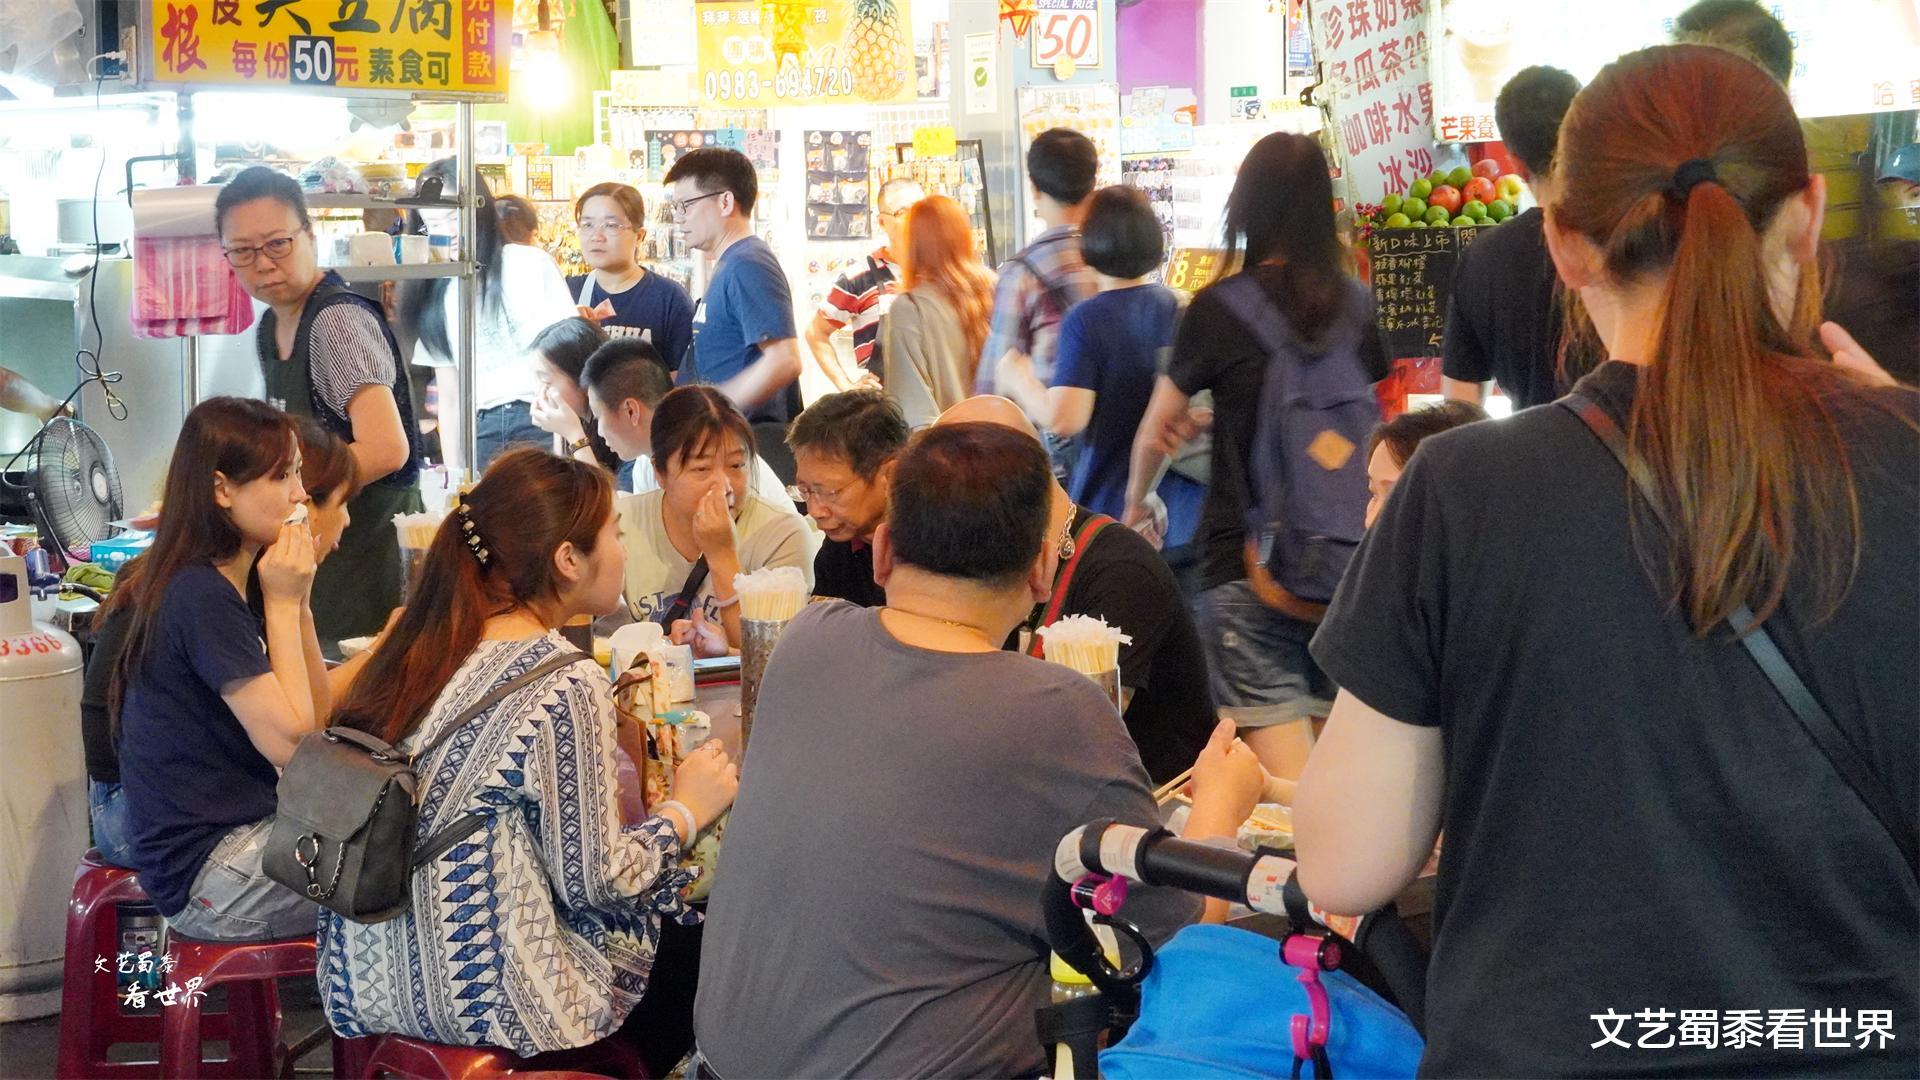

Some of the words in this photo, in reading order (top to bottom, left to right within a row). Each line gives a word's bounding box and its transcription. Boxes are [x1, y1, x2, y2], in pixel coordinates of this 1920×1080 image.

[1040, 14, 1092, 59] 50
[368, 47, 453, 86] 素食可
[704, 66, 853, 100] 0983-694720
